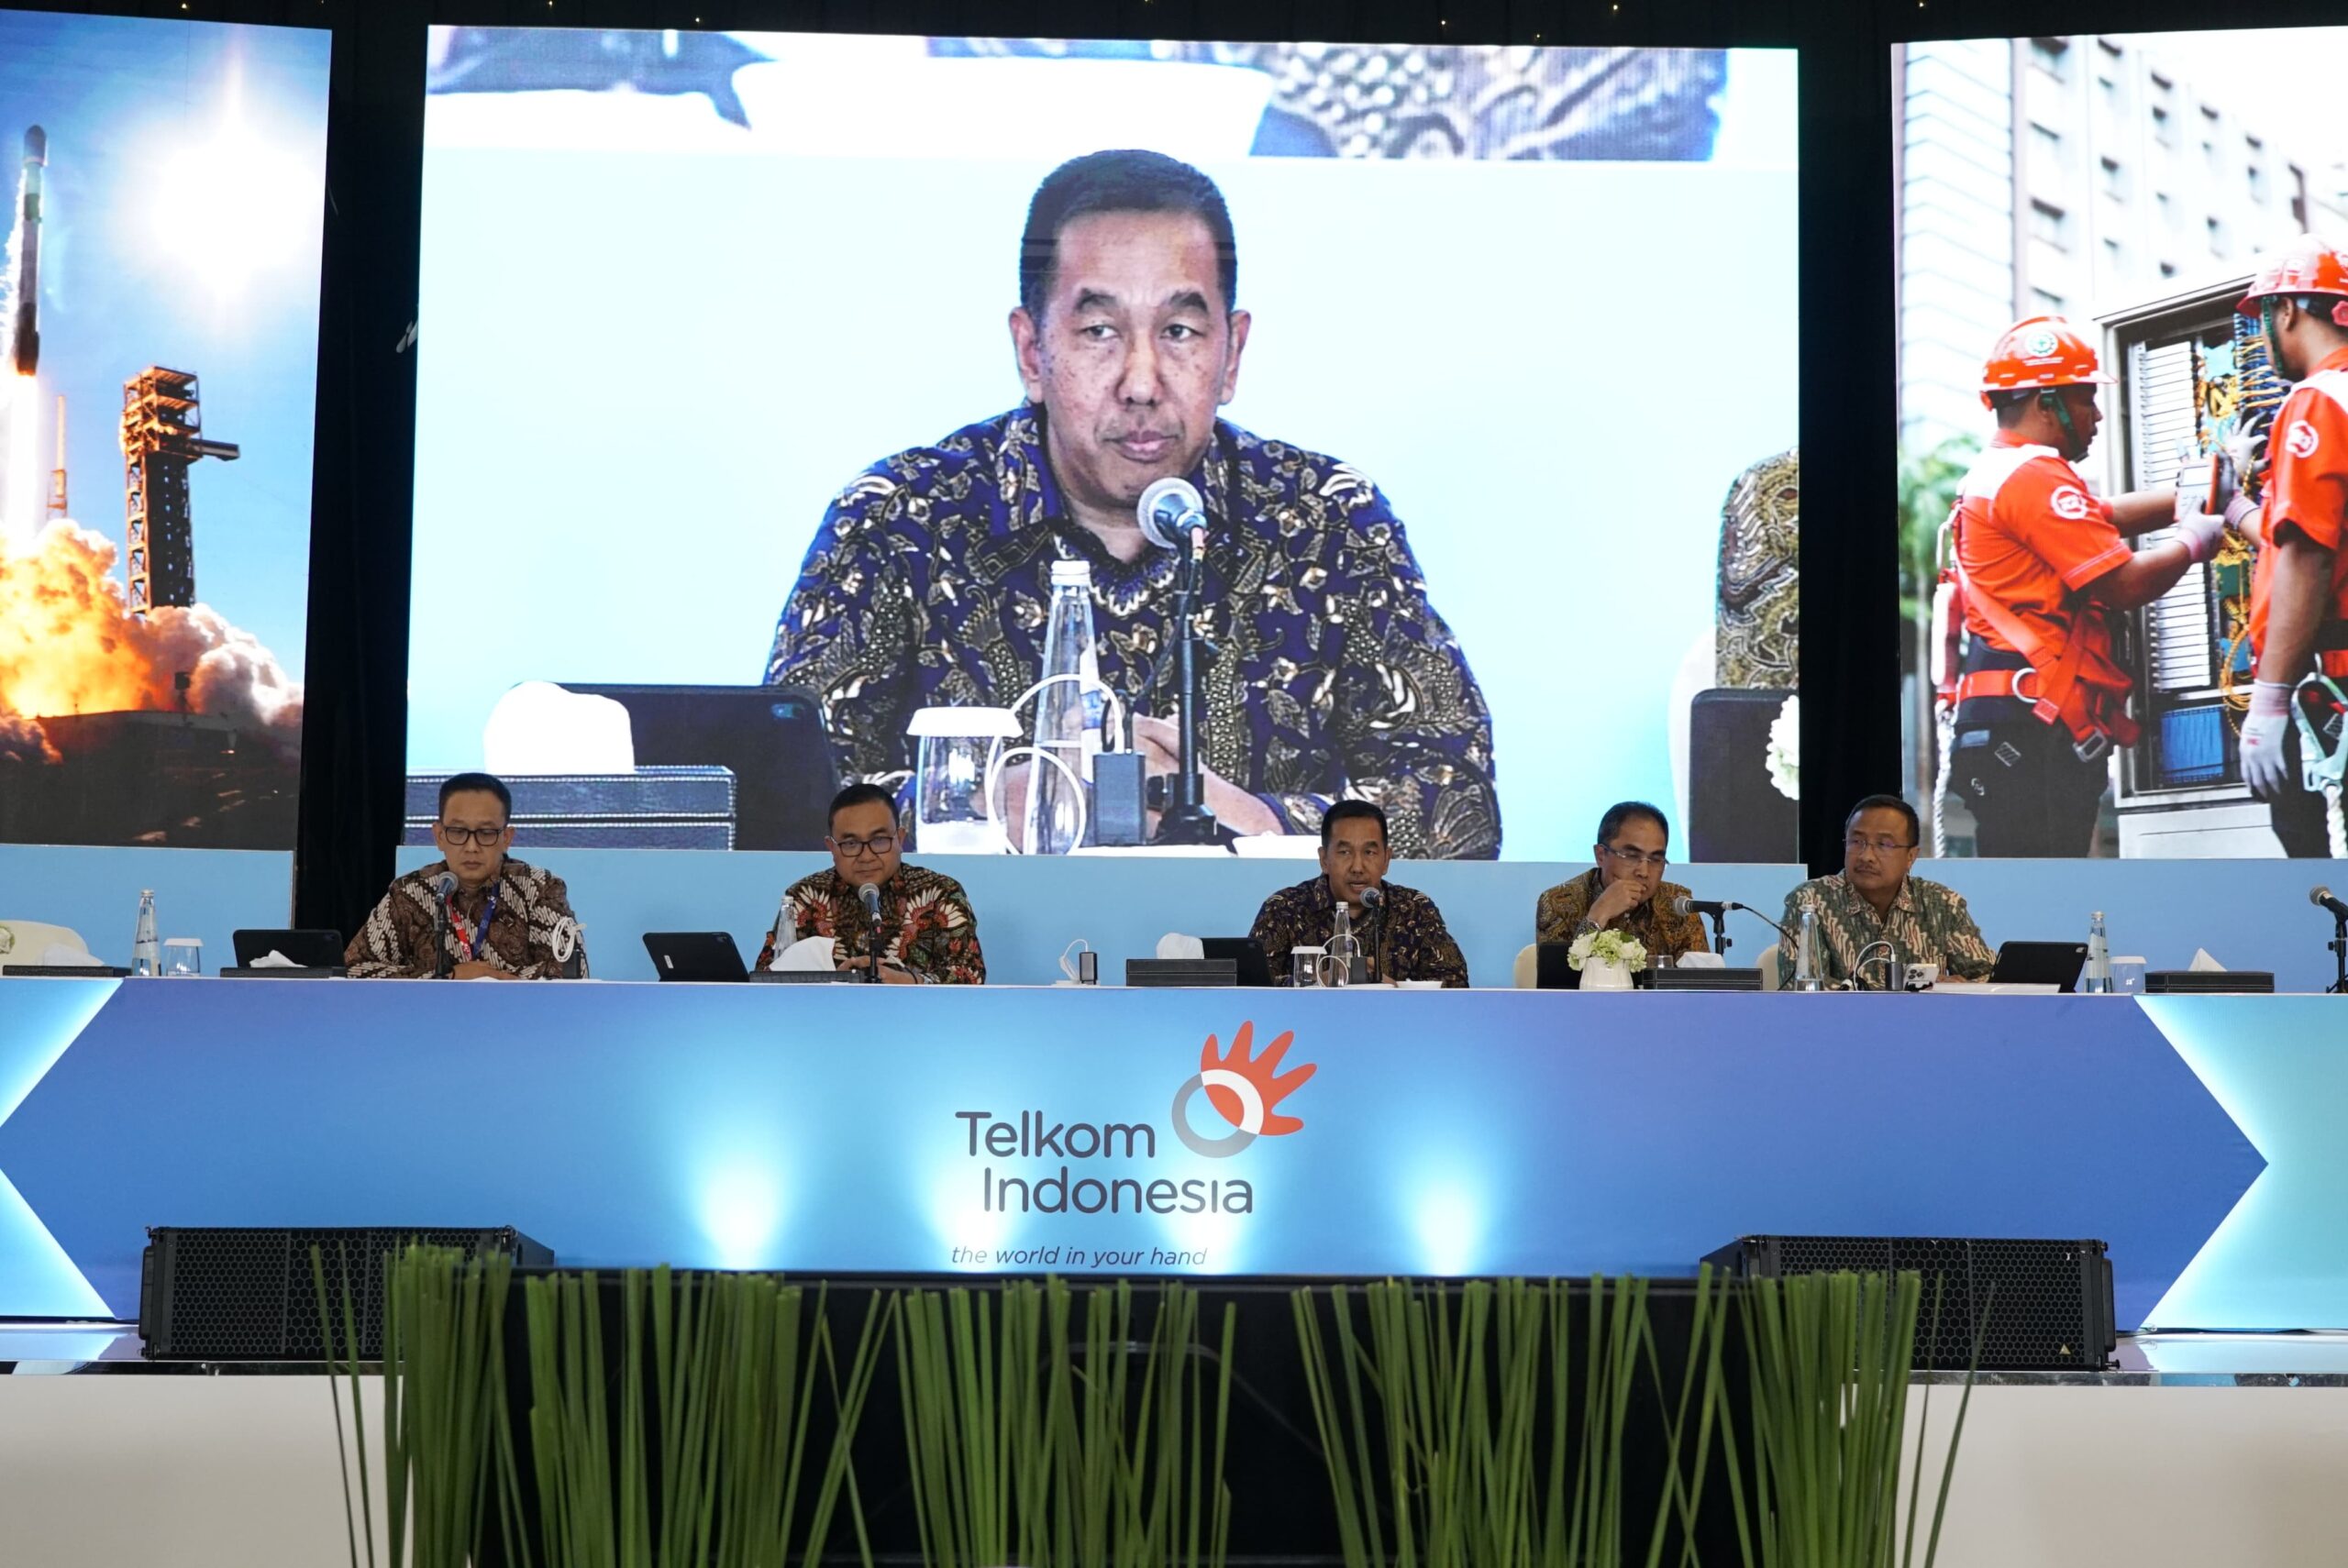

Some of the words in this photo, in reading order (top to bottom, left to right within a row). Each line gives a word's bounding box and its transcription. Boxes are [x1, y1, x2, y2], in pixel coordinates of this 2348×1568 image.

[955, 1110, 1156, 1158] Telkom
[984, 1165, 1253, 1214] Indonesia
[951, 1246, 987, 1264] the
[996, 1245, 1060, 1264] world
[1066, 1246, 1086, 1264] in
[1091, 1250, 1145, 1268] your
[1150, 1246, 1208, 1266] hand
